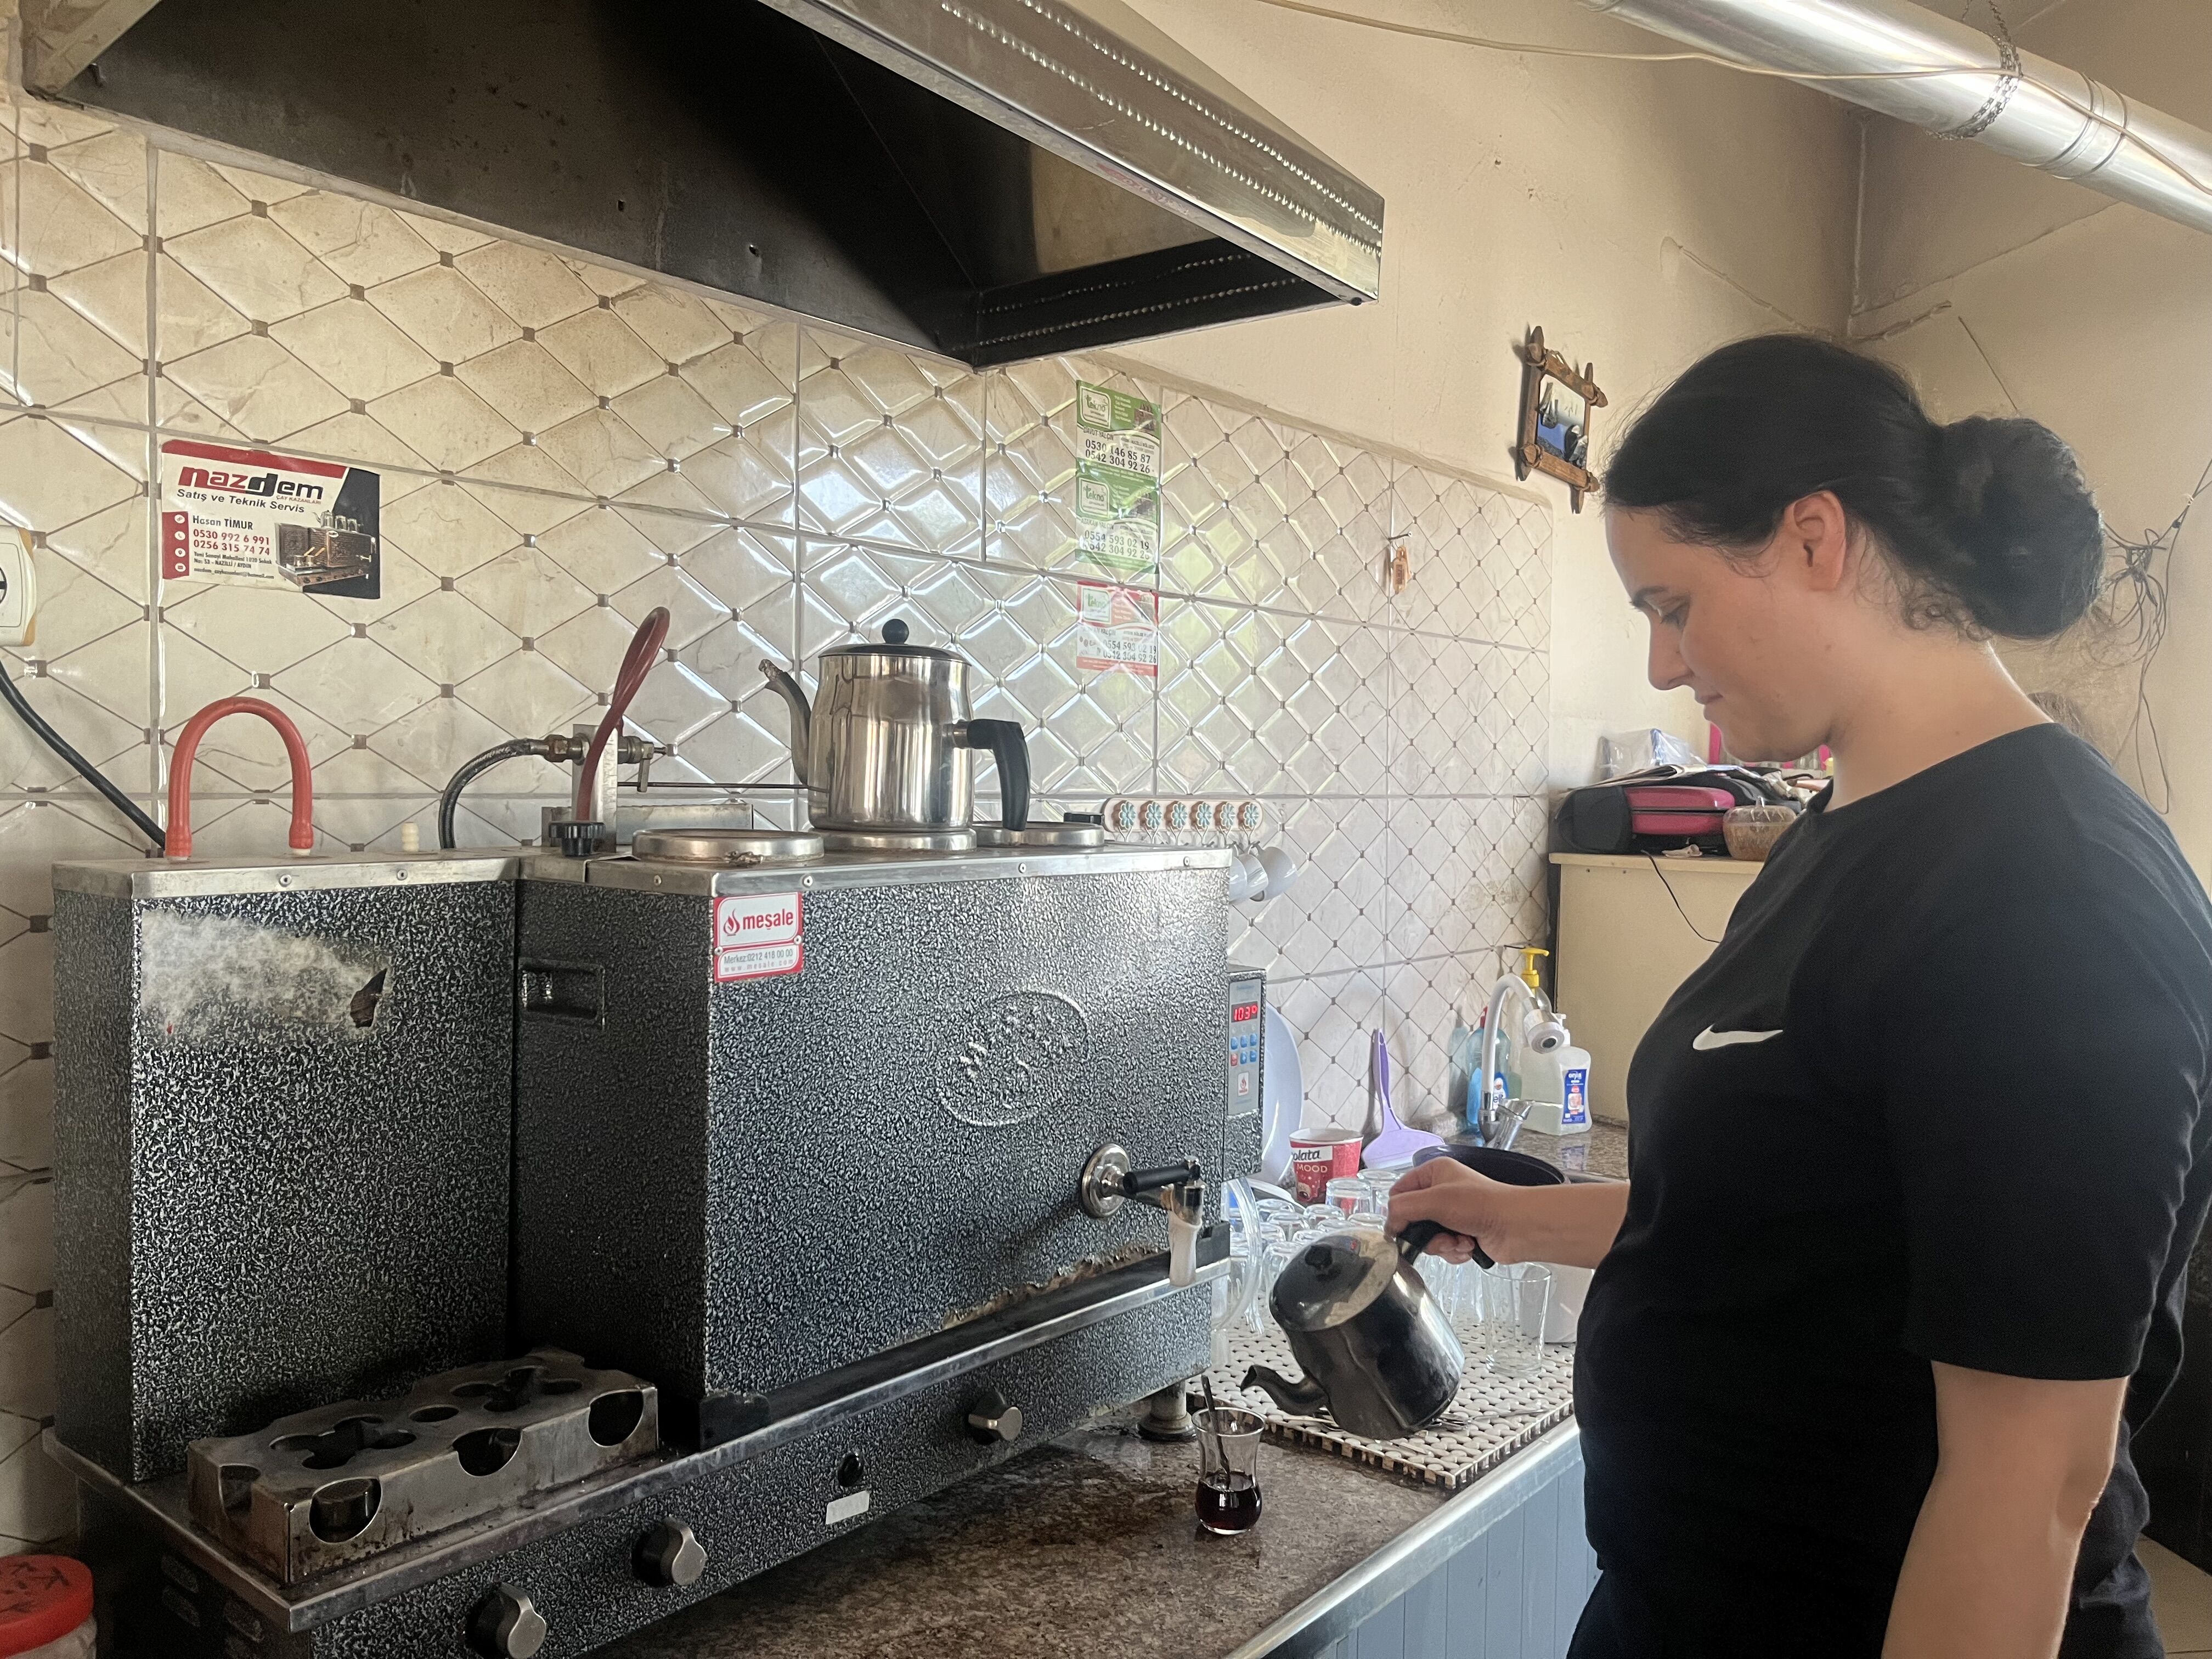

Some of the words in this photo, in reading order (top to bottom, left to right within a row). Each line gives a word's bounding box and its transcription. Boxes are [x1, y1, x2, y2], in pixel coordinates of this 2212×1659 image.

[1086, 439, 1107, 452] 0530
[1110, 446, 1125, 457] 146
[1127, 450, 1137, 460] 85
[1141, 454, 1150, 464] 87
[1086, 449, 1107, 462] 0542
[1109, 455, 1125, 467] 304
[1128, 461, 1138, 470] 92
[1140, 464, 1150, 473] 26
[178, 466, 324, 499] nazdem
[177, 489, 207, 502] Satış
[211, 494, 225, 503] ve
[229, 495, 266, 508] Teknik
[270, 501, 304, 513] Servis
[193, 515, 221, 526] Hasan
[224, 517, 253, 530] TİMUR
[194, 529, 218, 539] 0530
[221, 532, 240, 542] 992
[252, 535, 269, 545] 991
[1085, 530, 1105, 541] 0554
[1109, 535, 1124, 545] 593
[1127, 538, 1137, 548] 02
[1141, 540, 1149, 550] 19
[194, 539, 218, 550] 0256
[222, 543, 239, 552] 315
[244, 545, 255, 554] 74
[259, 546, 270, 555] 74
[1109, 545, 1124, 555] 304
[1127, 549, 1137, 557] 92
[1122, 642, 1136, 651] 593
[1122, 652, 1136, 661] 304
[1138, 654, 1147, 663] 92
[1149, 654, 1156, 664] 26
[743, 909, 793, 930] meşale
[764, 950, 775, 959] 418
[777, 949, 785, 958] 00
[786, 949, 793, 957] 00
[1291, 1149, 1321, 1160] olata
[1297, 1164, 1328, 1173] MOOD
